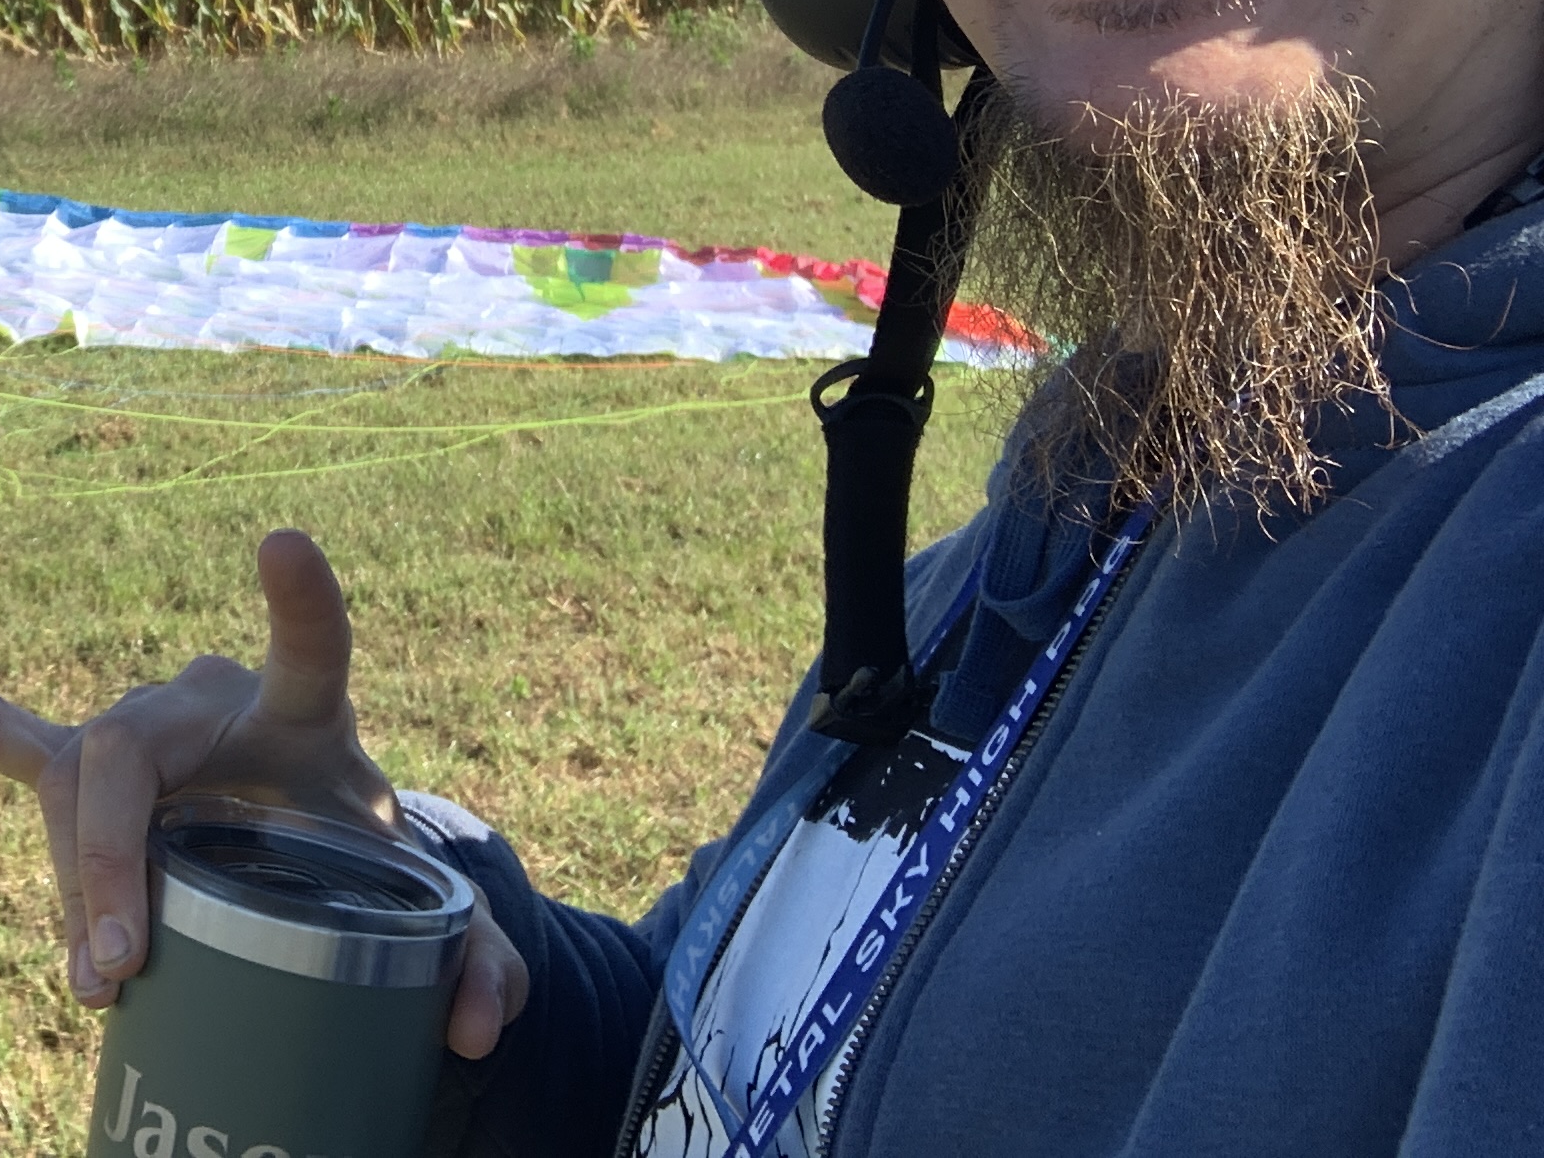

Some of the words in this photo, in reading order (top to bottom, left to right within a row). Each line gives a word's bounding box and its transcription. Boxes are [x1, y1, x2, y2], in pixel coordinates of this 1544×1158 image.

[856, 842, 929, 973] SKY
[939, 678, 1037, 832] HIGH
[1046, 535, 1131, 661] PPG
[104, 1063, 354, 1158] Jas
